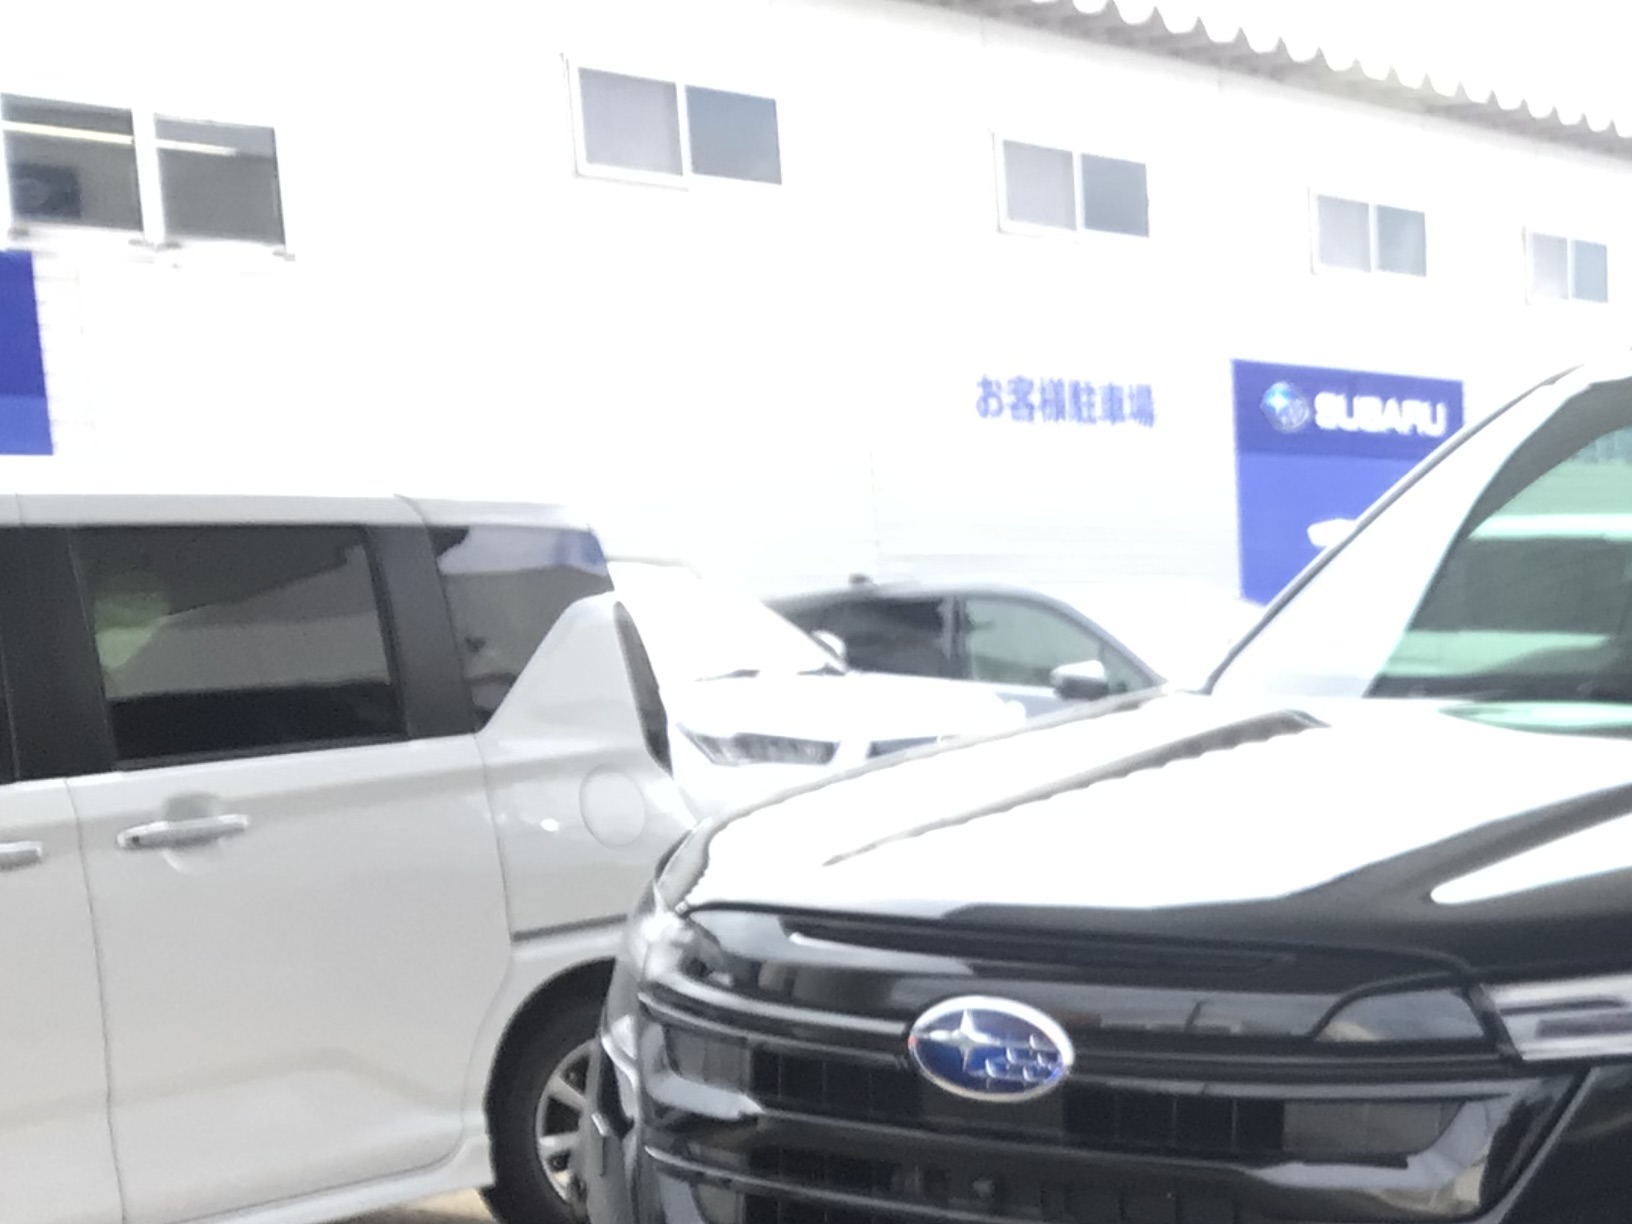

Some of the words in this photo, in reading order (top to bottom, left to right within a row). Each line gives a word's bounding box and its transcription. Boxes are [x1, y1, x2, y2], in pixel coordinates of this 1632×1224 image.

[976, 374, 1156, 428] お客様駐車場
[1315, 392, 1447, 436] SUBARU
